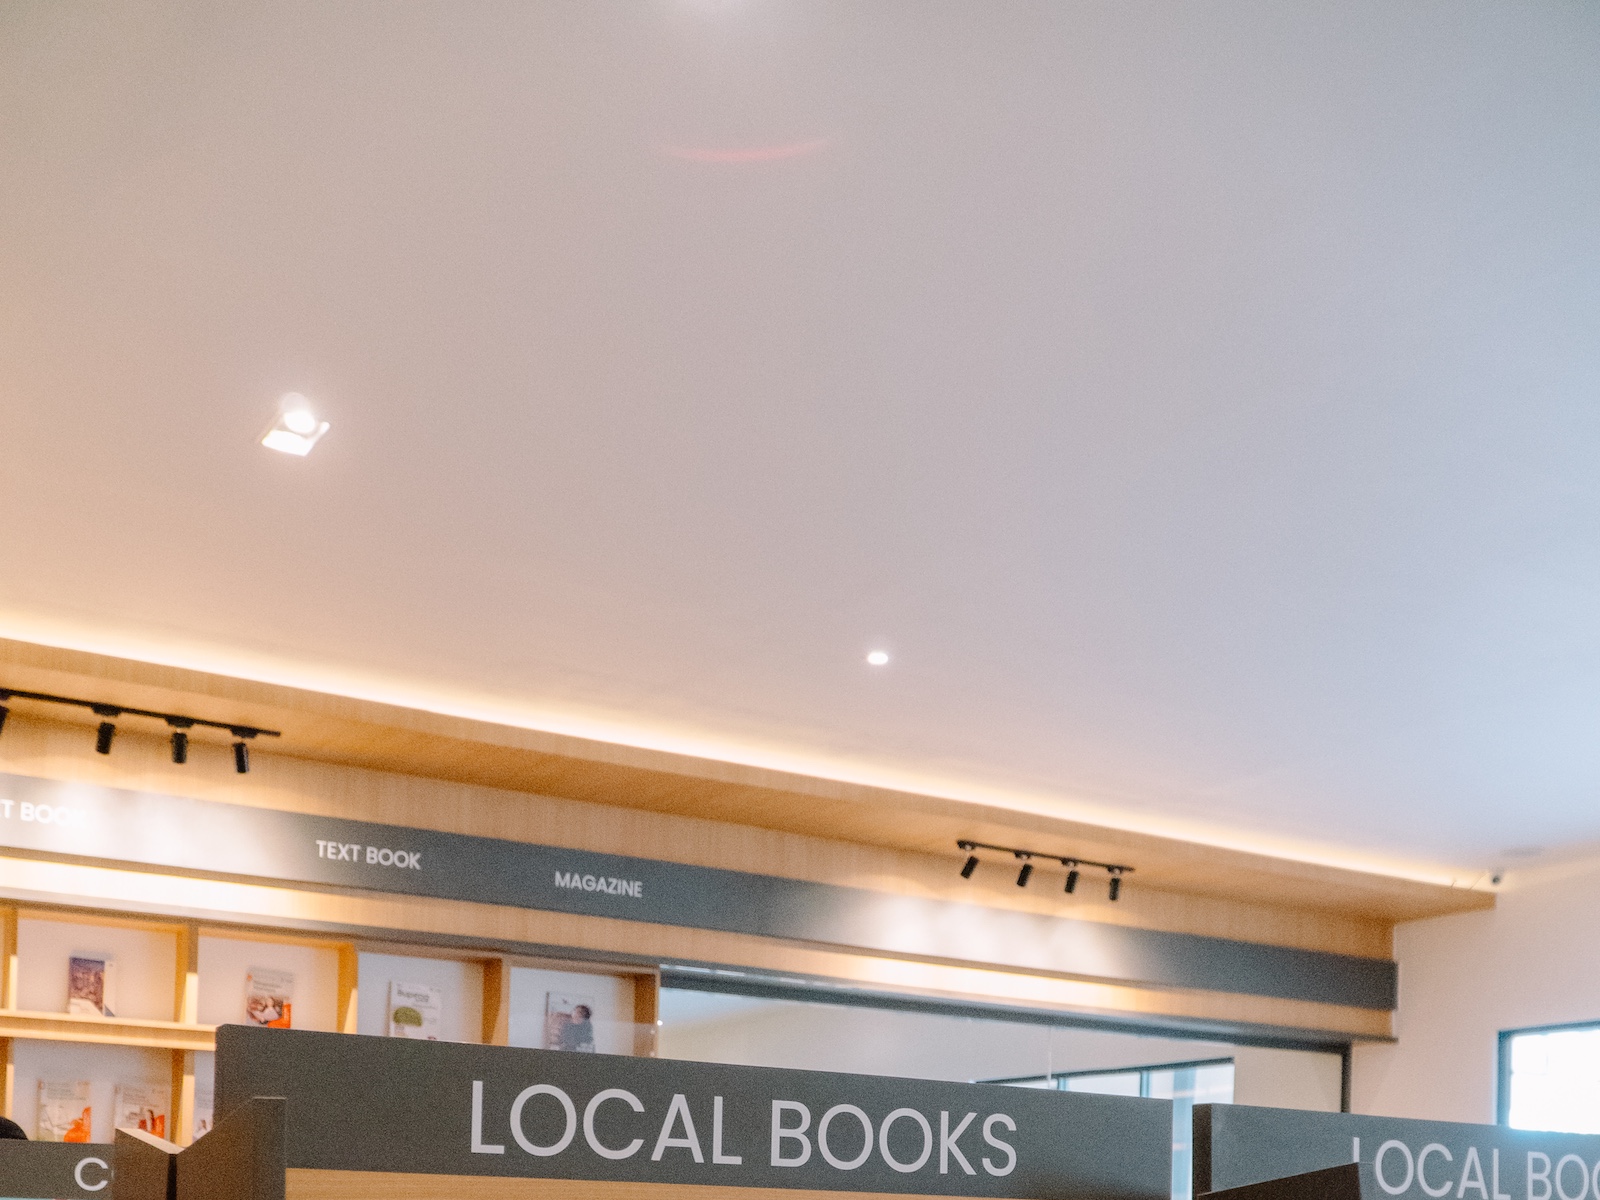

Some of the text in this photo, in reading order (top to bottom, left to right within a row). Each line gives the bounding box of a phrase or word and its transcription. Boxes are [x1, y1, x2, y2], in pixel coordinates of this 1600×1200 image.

[316, 840, 421, 870] TEXT BOOK
[554, 870, 643, 898] MAGAZINE
[470, 1080, 1017, 1177] LOCAL BOOKS
[74, 1157, 114, 1191] C
